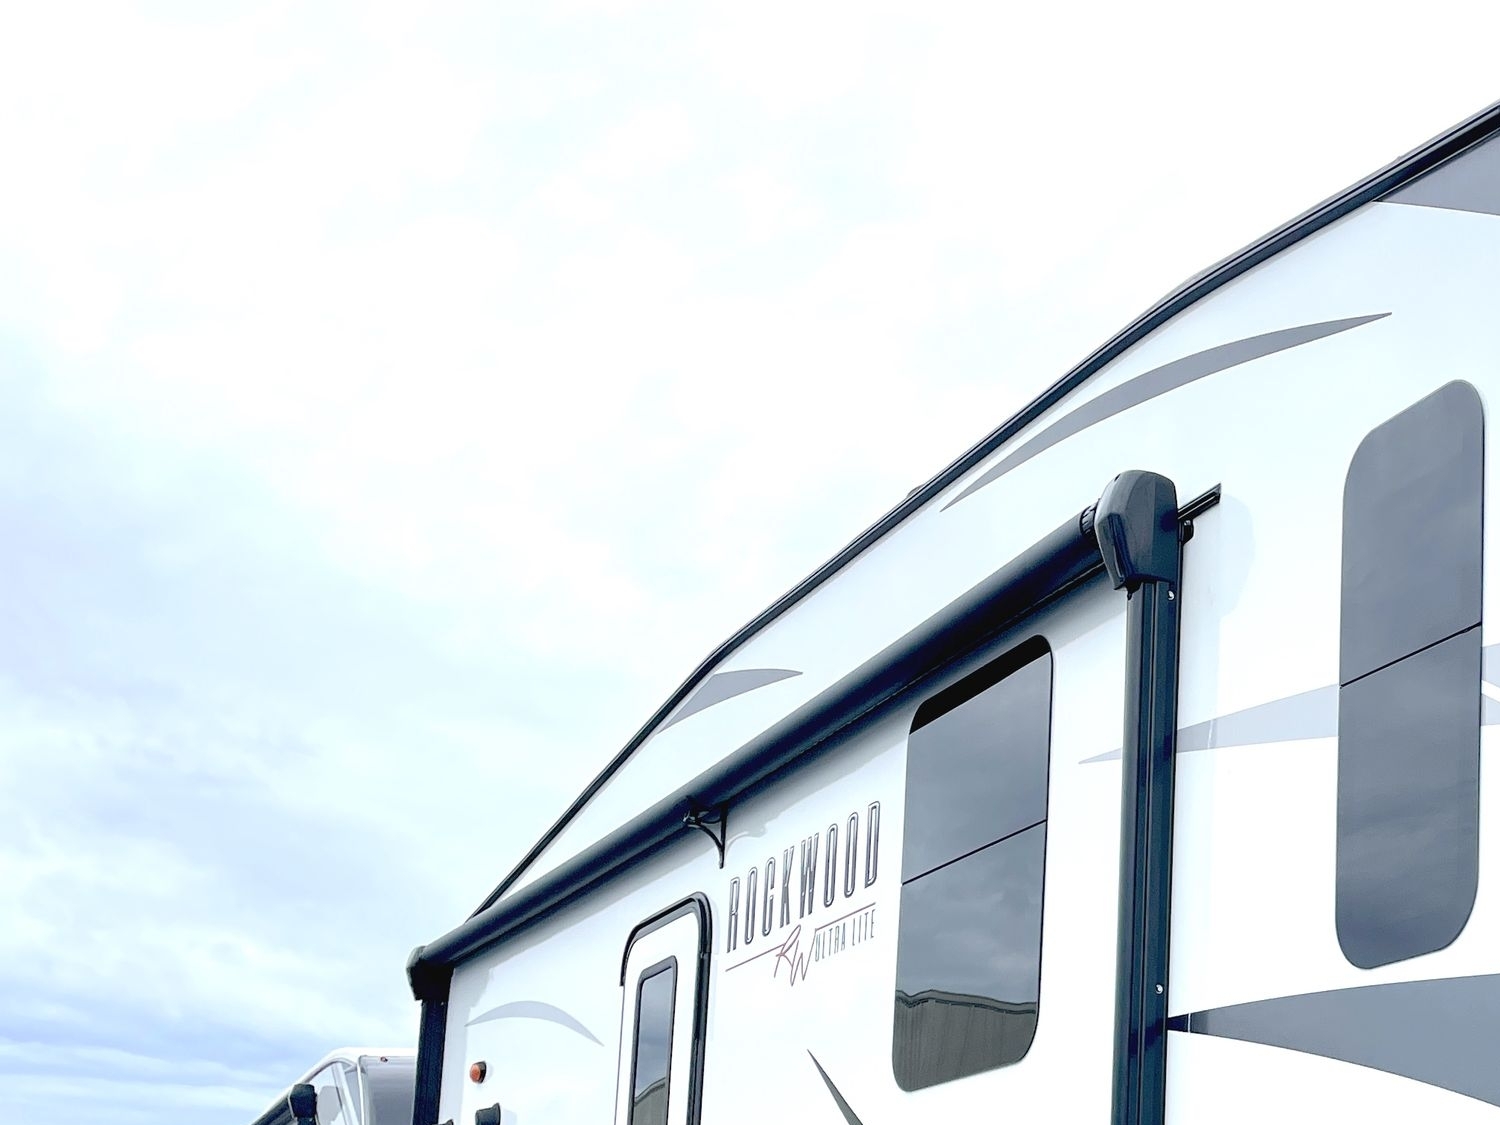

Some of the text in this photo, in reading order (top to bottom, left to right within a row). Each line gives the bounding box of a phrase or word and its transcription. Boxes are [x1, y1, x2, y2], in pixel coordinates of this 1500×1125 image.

[726, 800, 881, 954] ROCKWOOD
[814, 922, 846, 962] ULTRA
[852, 908, 877, 947] LITE
